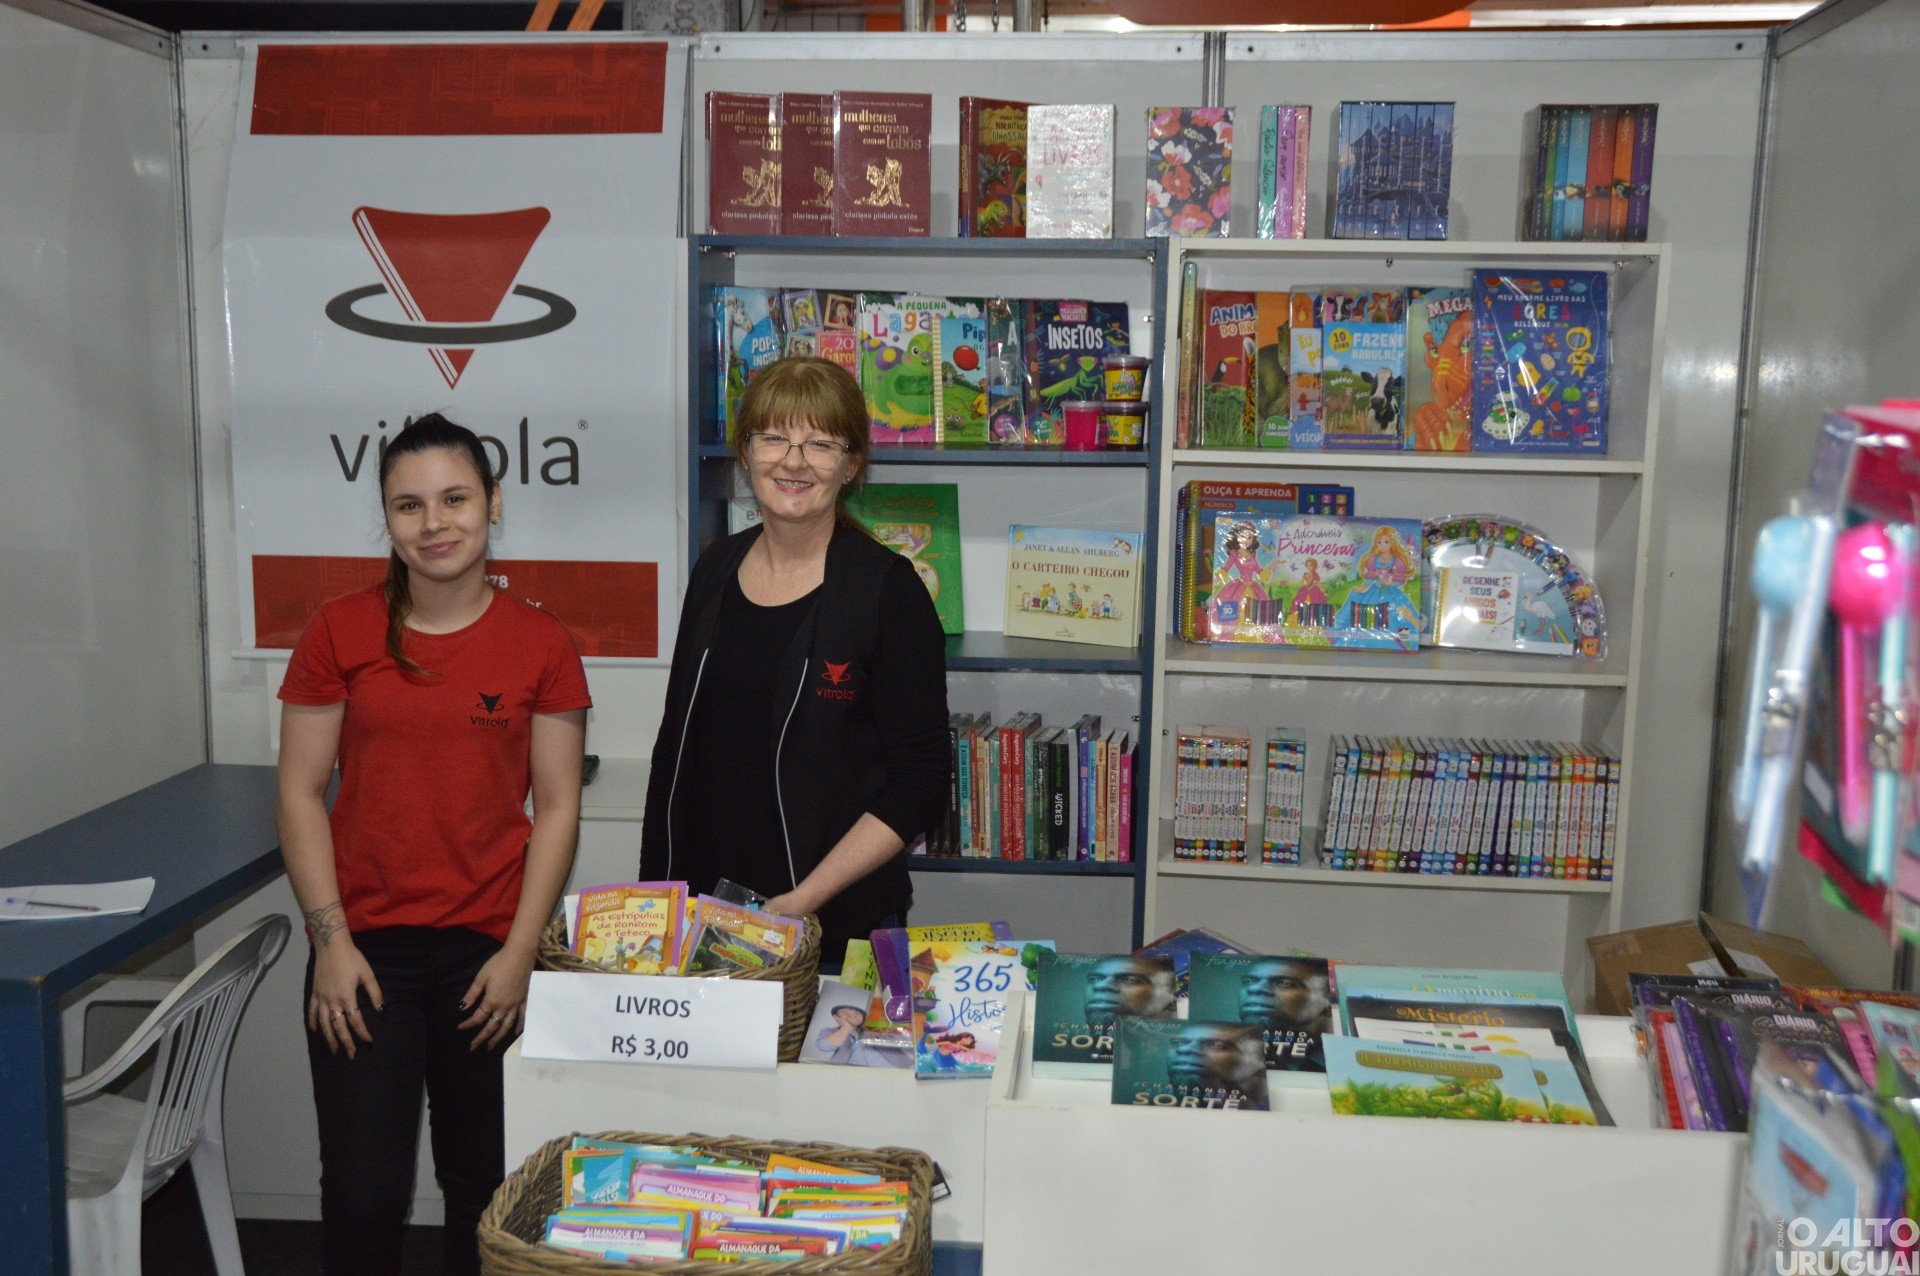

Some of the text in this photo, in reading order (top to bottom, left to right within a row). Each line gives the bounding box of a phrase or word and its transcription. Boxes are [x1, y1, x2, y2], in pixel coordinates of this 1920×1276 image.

[844, 109, 897, 123] mulheres
[886, 133, 922, 150] lobos
[992, 131, 1027, 142] DINOSSAU
[905, 301, 947, 312] PEQUENA
[1546, 295, 1568, 303] LIVRO
[1210, 302, 1256, 324] ANIM
[1512, 303, 1572, 321] CORES
[873, 310, 932, 338] Laga
[1219, 324, 1238, 339] DO
[1047, 323, 1104, 350] INSETOS
[1333, 331, 1347, 344] 10
[821, 348, 855, 363] Garo
[1294, 429, 1322, 443] VEÍCU
[330, 416, 580, 486] viola
[1203, 485, 1292, 499] OUÇA E APRENDA
[1023, 543, 1048, 552] JANET
[1057, 545, 1080, 555] ALLAN
[1083, 547, 1120, 558] AHLBERG
[1276, 537, 1357, 557] Princesas
[1011, 560, 1130, 579] O CARTEIRO CHEGOU
[1462, 575, 1501, 587] DESENHE
[1469, 586, 1492, 596] SEUS
[1054, 792, 1063, 826] WICKED
[596, 922, 611, 930] de
[954, 961, 1013, 993] 365
[615, 995, 691, 1018] LIVROS
[1731, 993, 1772, 1005] DIÁRIO
[1052, 1022, 1115, 1031] #CHAMA
[1773, 1013, 1816, 1029] DIÁRIO
[611, 1034, 690, 1061] R$ 3,00
[1051, 1033, 1114, 1050] SOR
[1132, 1091, 1241, 1110] SORTE
[666, 1184, 726, 1204] ALMANAQUE DO
[584, 1227, 646, 1241] ALMANAQUE DA
[854, 1230, 868, 1240] DA
[719, 1243, 781, 1256] ALMANAQUE DA
